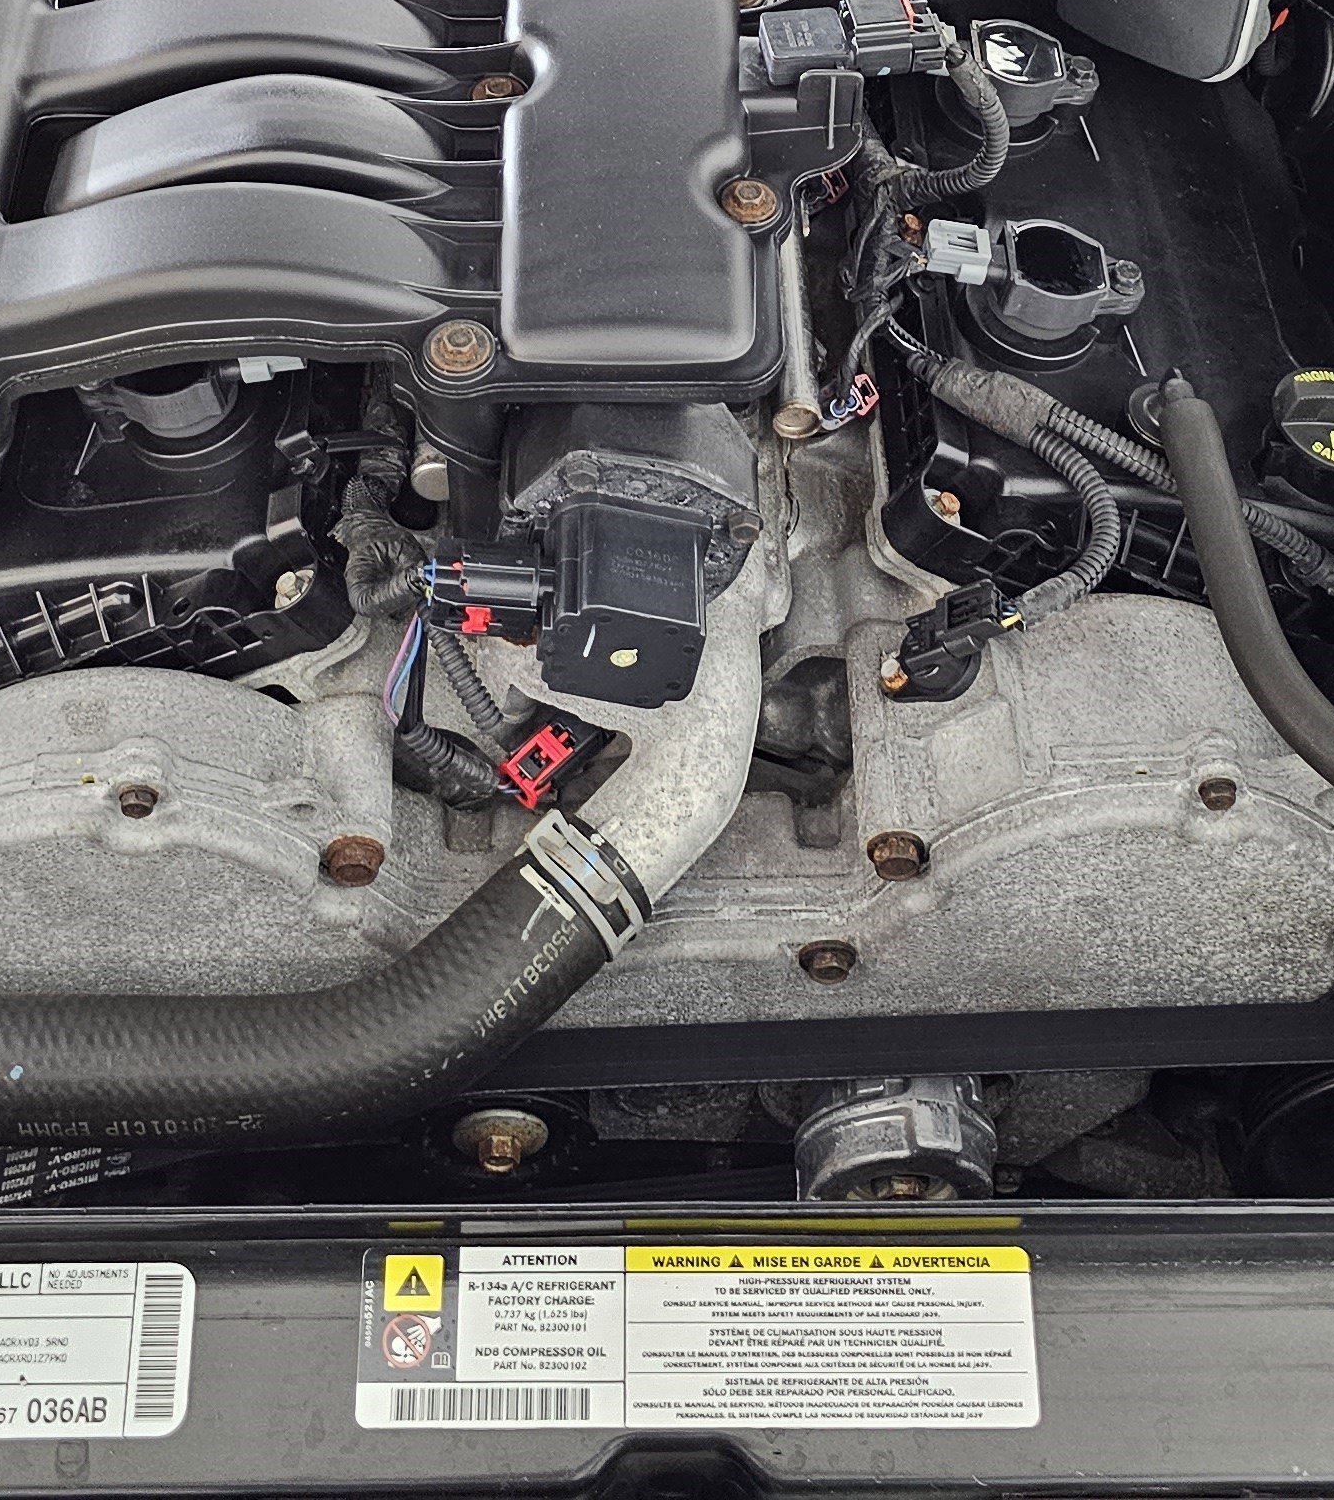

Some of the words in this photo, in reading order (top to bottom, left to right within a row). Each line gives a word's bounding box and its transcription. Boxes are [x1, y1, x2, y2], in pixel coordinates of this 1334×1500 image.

[503, 1254, 577, 1266] ATTENTION
[653, 1256, 720, 1268] WARNING
[753, 1256, 787, 1268] MISE
[792, 1256, 809, 1268] EN
[814, 1256, 860, 1268] GARDE
[893, 1256, 989, 1268] ADVERTENCIA
[48, 1270, 64, 1279] NO
[66, 1269, 129, 1279] ADJUSTMENTS
[47, 1280, 83, 1289] NEEDED
[469, 1280, 507, 1292] R-134a
[511, 1280, 533, 1294] A/C
[537, 1280, 615, 1292] REFRIGERANT
[739, 1277, 809, 1286] HIGH-PRESSURE
[813, 1277, 872, 1286] REFRIGERANT
[877, 1277, 911, 1286] SYSTEM
[715, 1287, 726, 1296] TO
[729, 1287, 740, 1296] BE
[743, 1287, 786, 1296] SERVICED
[789, 1287, 799, 1296] BY
[803, 1287, 850, 1296] QUALIFIED
[853, 1287, 905, 1296] PERSONNEL
[909, 1287, 934, 1296] ONLY.
[489, 1295, 539, 1307] FACTORY
[545, 1295, 594, 1307] CHARGE:
[495, 1323, 517, 1333] PART
[540, 1323, 586, 1333] 82300101
[753, 1327, 764, 1337] DE
[767, 1327, 835, 1337] CLIMATISATION
[839, 1327, 863, 1337] SOUS
[866, 1327, 895, 1337] HAUTE
[899, 1327, 942, 1337] PRESSION
[476, 1346, 499, 1358] ND8
[503, 1346, 583, 1358] COMPRESSOR
[587, 1346, 606, 1358] OIL
[494, 1360, 516, 1371] PART
[540, 1360, 586, 1371] 82300102
[26, 1395, 108, 1424] 036AB
